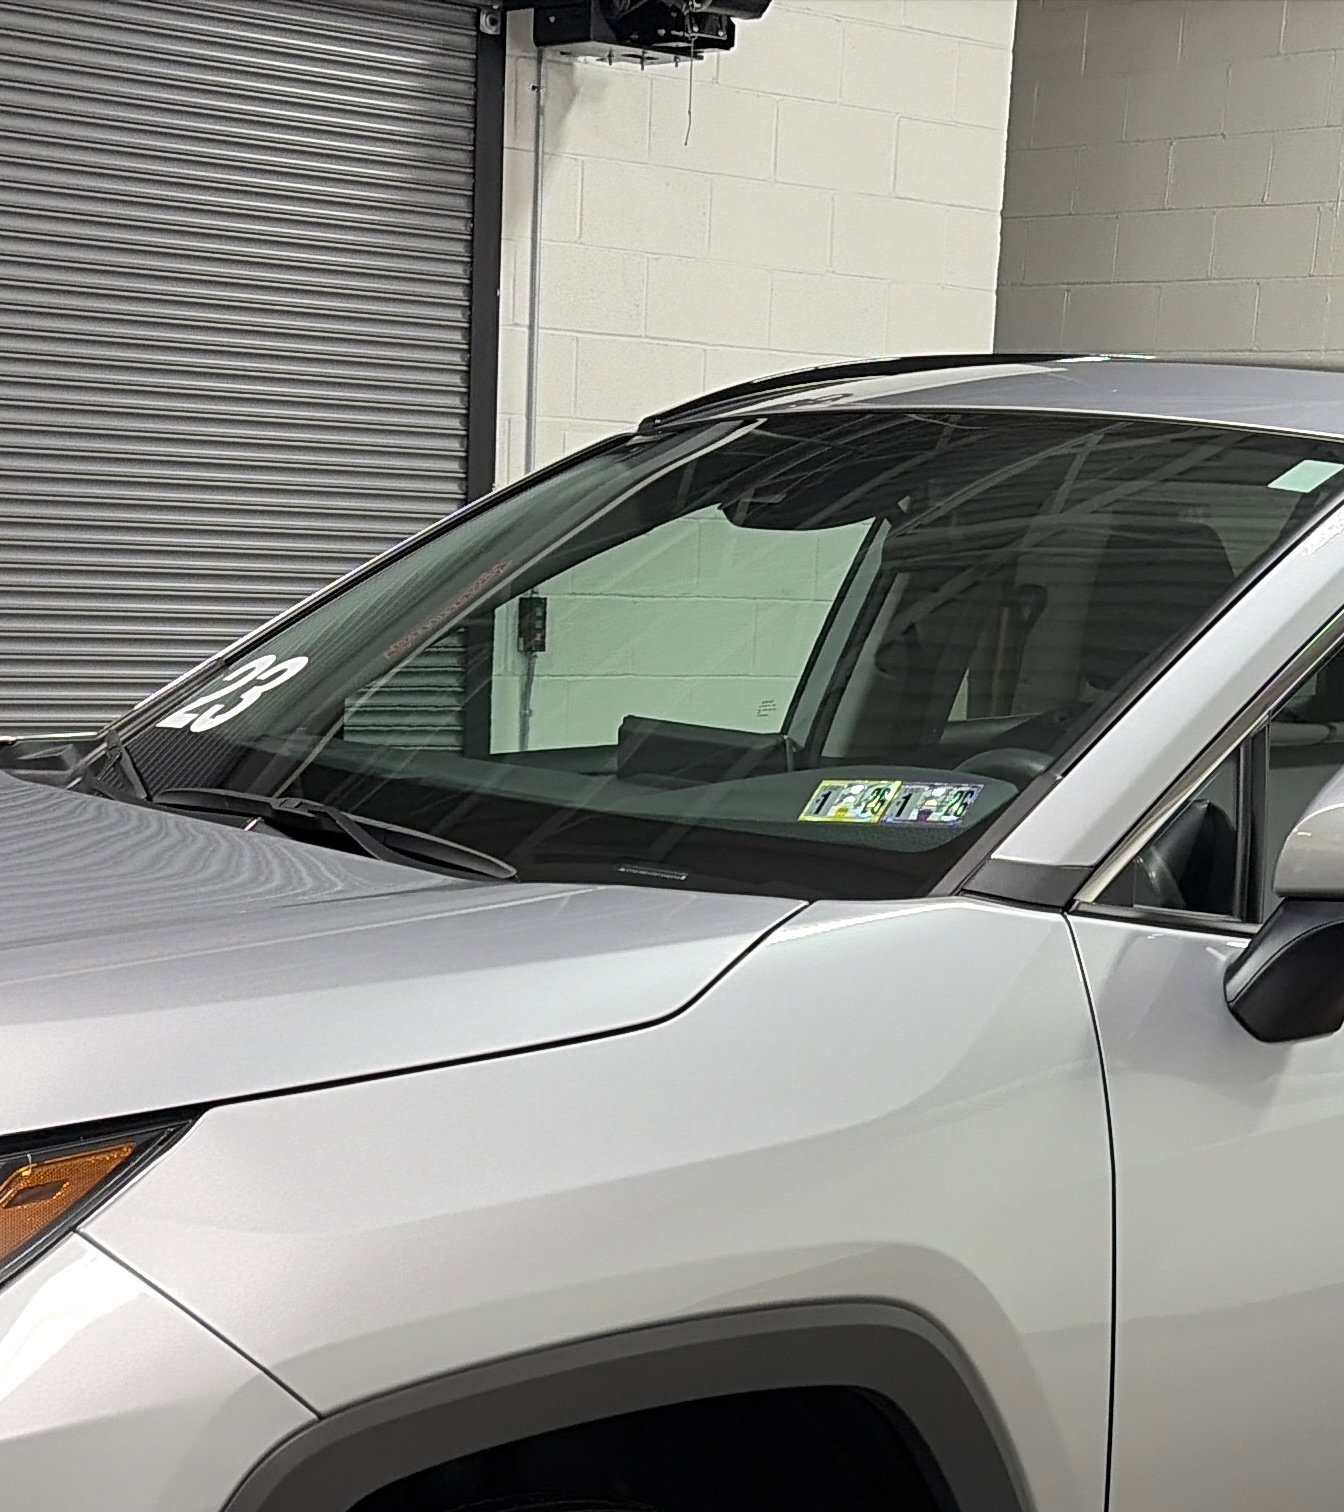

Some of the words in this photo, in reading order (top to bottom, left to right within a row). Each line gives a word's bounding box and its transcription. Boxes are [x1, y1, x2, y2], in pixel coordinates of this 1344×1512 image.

[155, 654, 309, 733] 23
[814, 790, 832, 815] 1
[895, 792, 913, 818] 1
